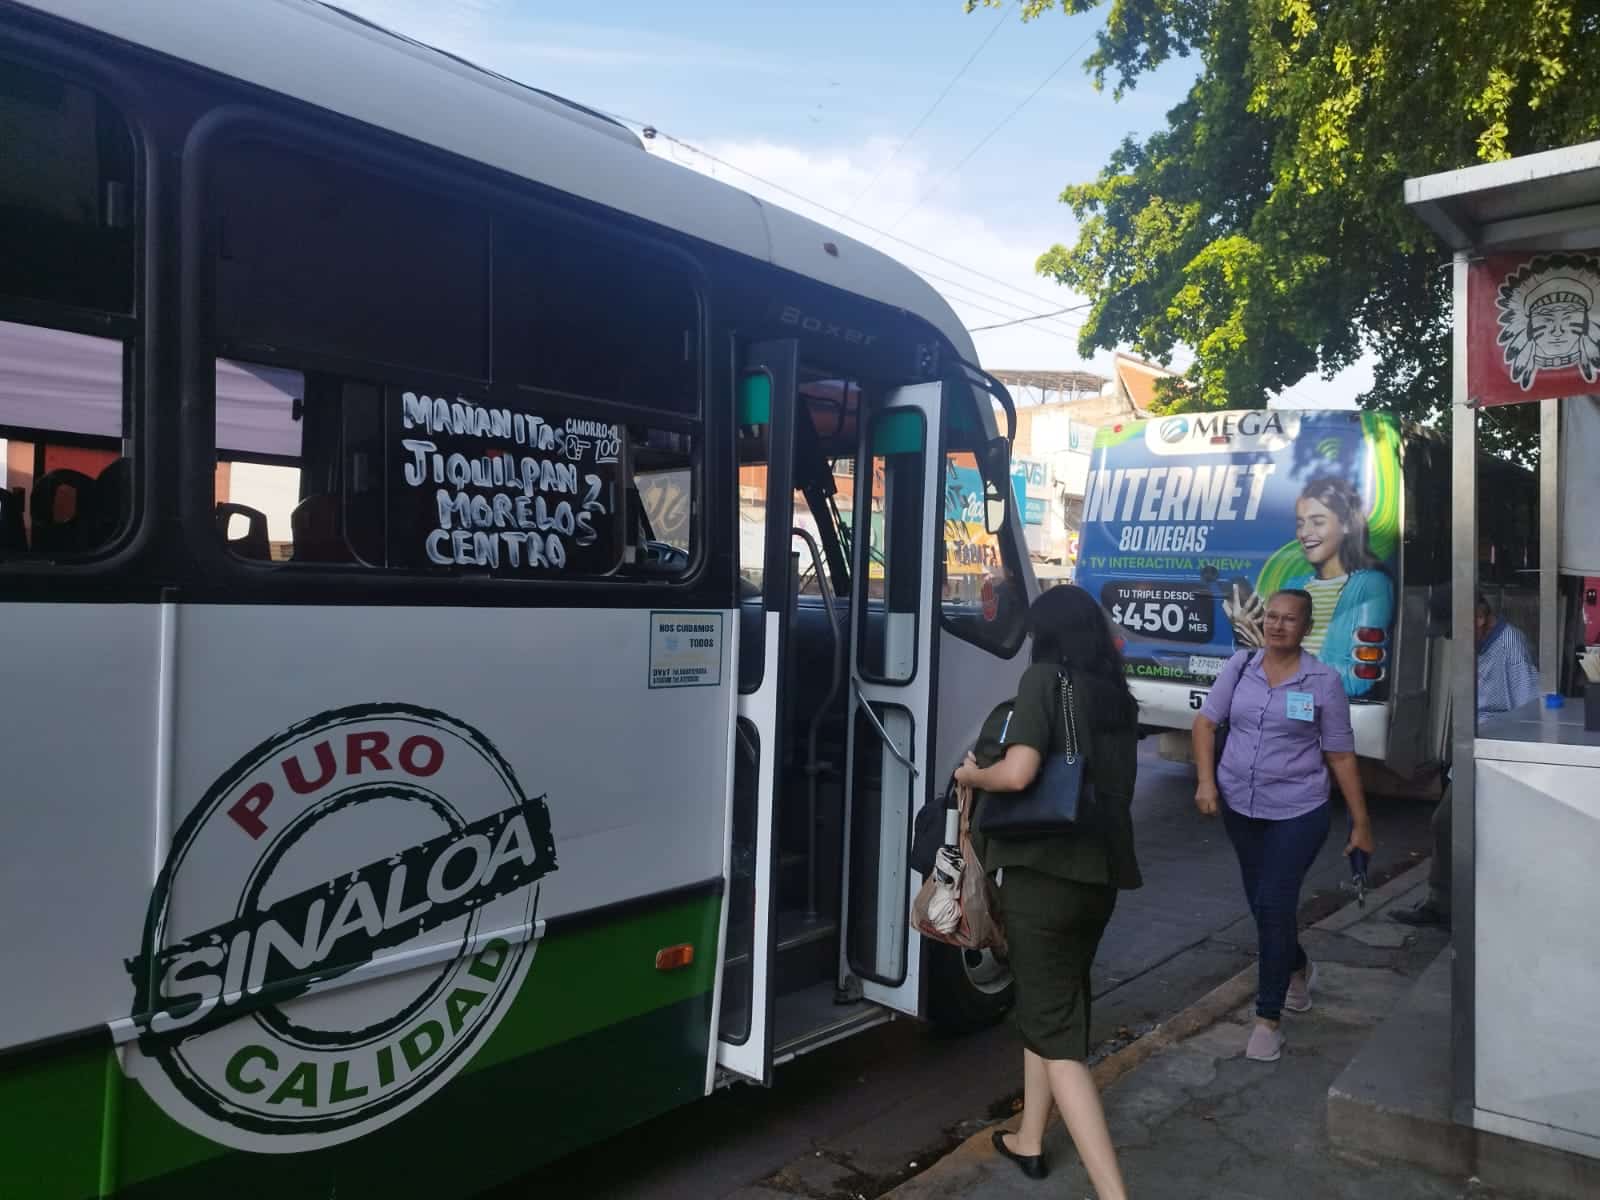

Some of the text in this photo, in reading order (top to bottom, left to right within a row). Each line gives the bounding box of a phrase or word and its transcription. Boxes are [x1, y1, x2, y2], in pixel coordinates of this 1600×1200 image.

[780, 304, 877, 345] Boxer
[1192, 410, 1285, 439] MEGA
[595, 439, 621, 460] 100
[402, 439, 578, 497] JIQUILPAN
[1085, 463, 1276, 522] INTERNET
[437, 489, 598, 547] MORELOS
[425, 529, 566, 569] CENTRO
[1118, 526, 1145, 551] 80
[1089, 557, 1106, 569] TV
[1109, 557, 1193, 569] INTERACTIVA
[1118, 589, 1195, 601] TU TRIPLE DESDE
[659, 624, 714, 633] NOS CUIDAMOS
[1188, 612, 1200, 622] AL
[1188, 623, 1208, 633] MES
[689, 638, 714, 648] TODOS
[227, 730, 444, 840] PURO
[150, 814, 536, 1033] SINALOA
[225, 937, 510, 1107] CALIDAD
